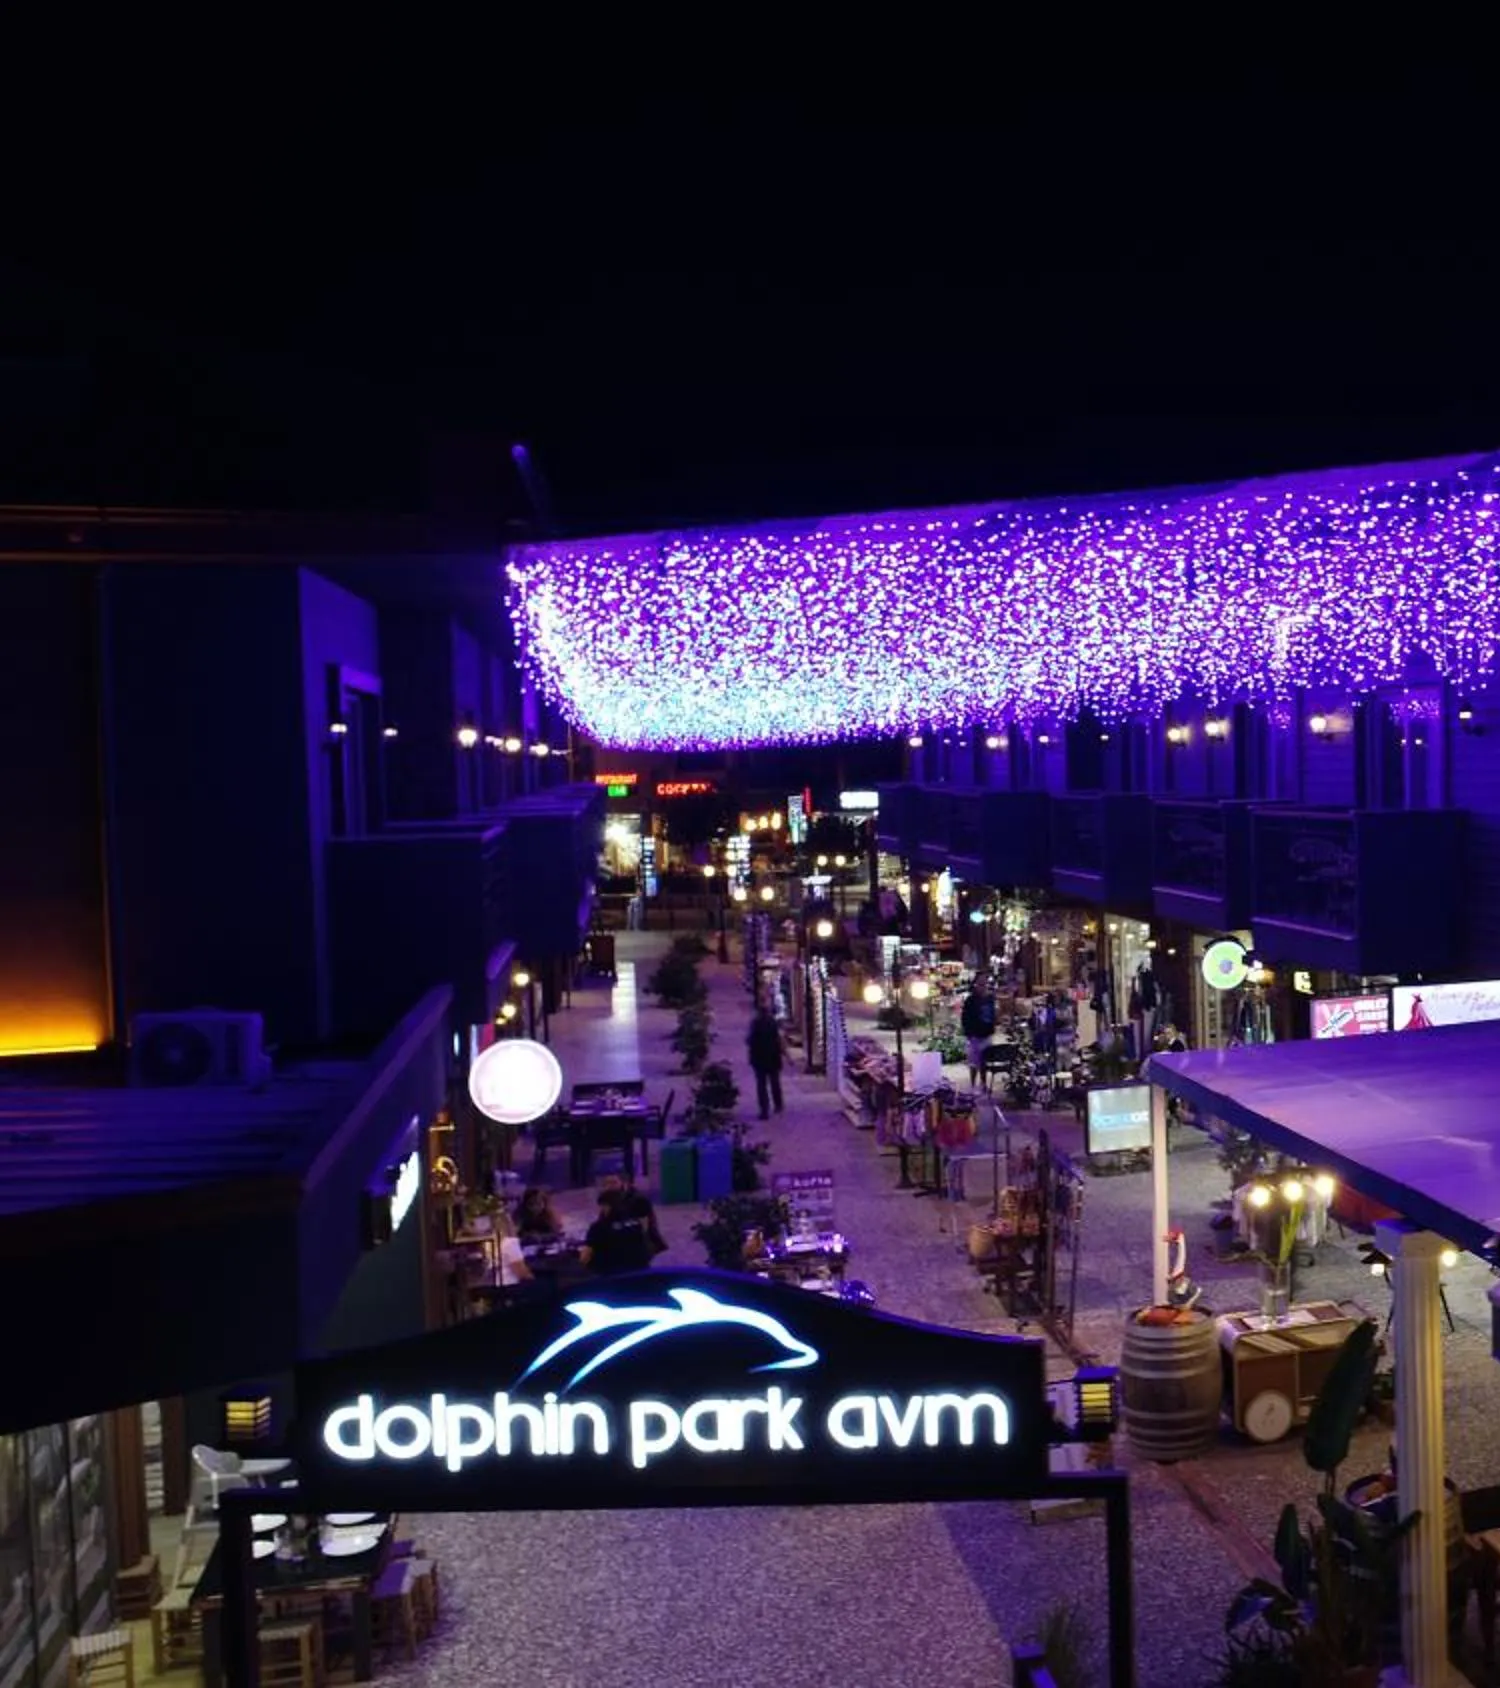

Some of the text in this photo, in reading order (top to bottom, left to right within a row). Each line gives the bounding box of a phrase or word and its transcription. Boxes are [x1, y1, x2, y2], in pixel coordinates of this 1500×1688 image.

[322, 1386, 1010, 1473] dolphin park avm
